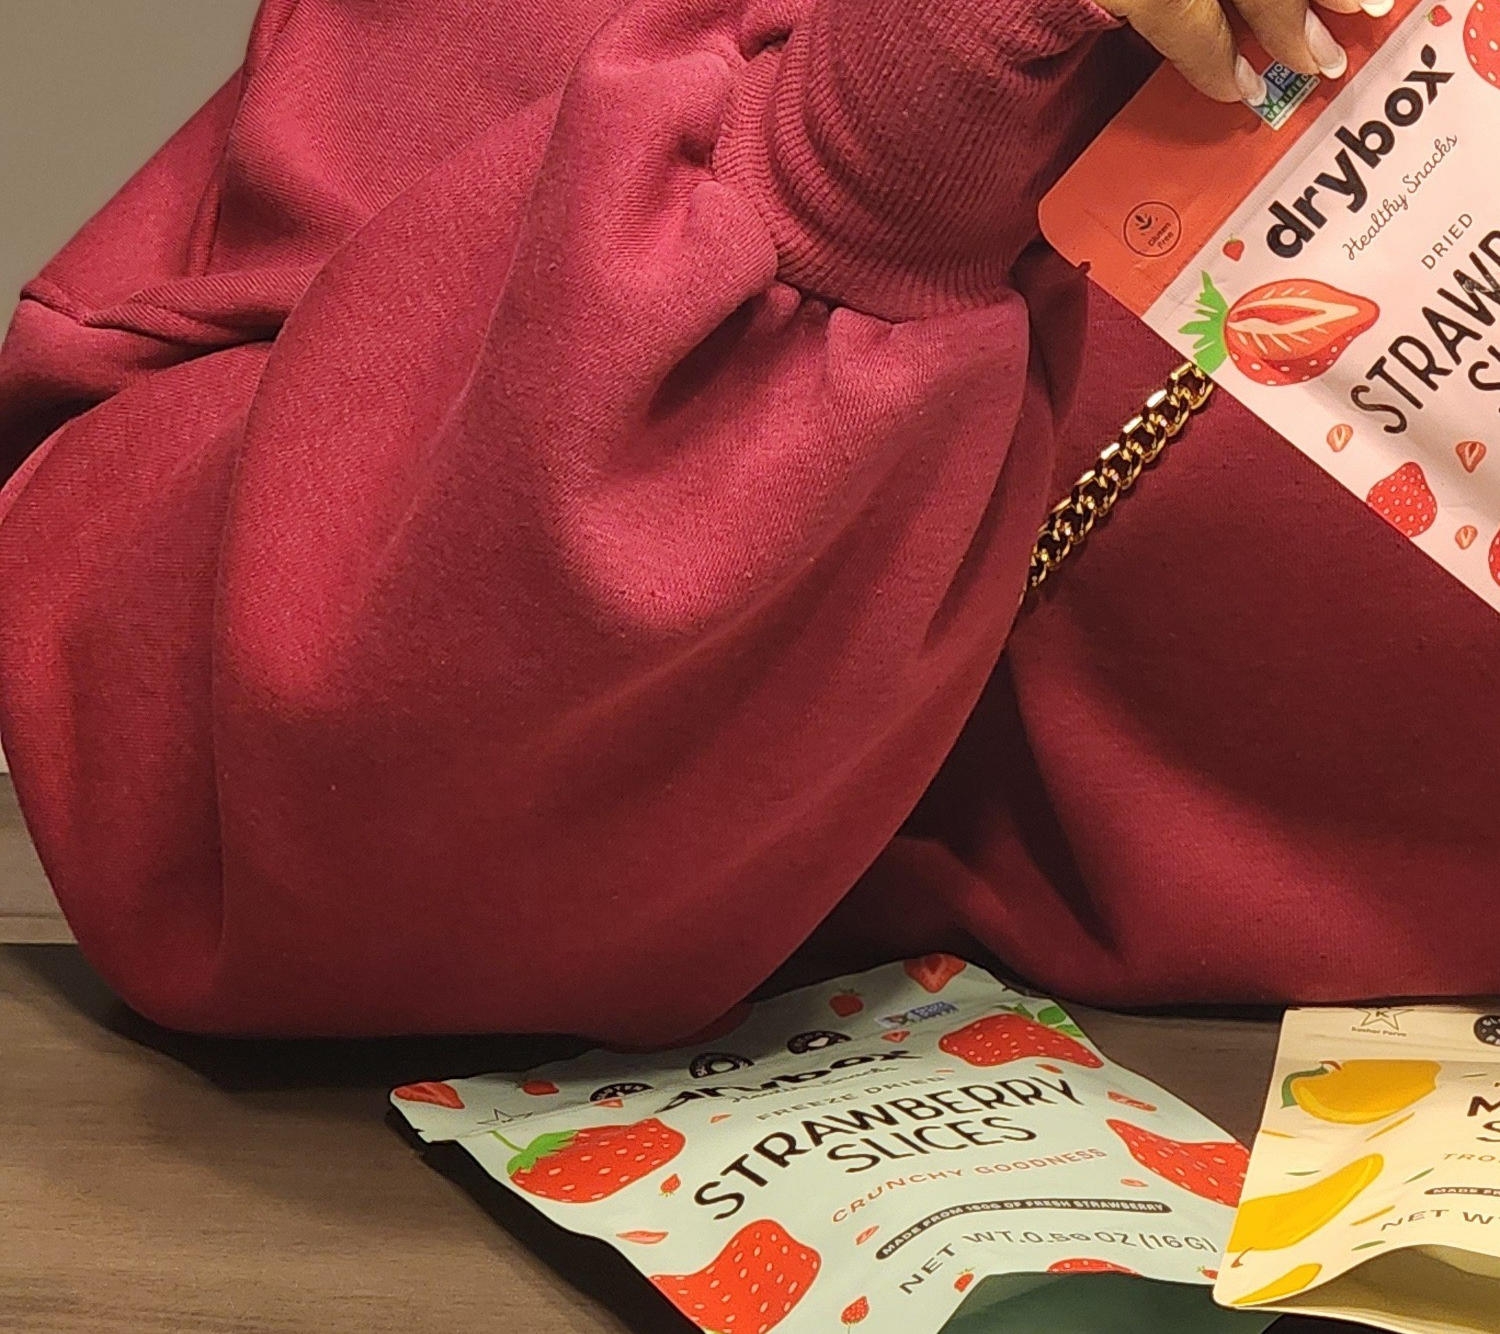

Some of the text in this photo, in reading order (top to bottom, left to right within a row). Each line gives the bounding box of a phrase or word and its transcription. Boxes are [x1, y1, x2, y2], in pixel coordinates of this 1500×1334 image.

[1267, 44, 1455, 258] drybox
[1342, 134, 1458, 261] Healthy Snacks
[1421, 213, 1474, 270] DRIED
[756, 1076, 946, 1121] FREEZE DRIED
[694, 1076, 1084, 1220] STRAWBERRY
[827, 1117, 1037, 1174] SLICES
[832, 1147, 1108, 1223] CRUNCHY GOODNESS
[1380, 1209, 1450, 1232] NET
[899, 1243, 957, 1294] NET
